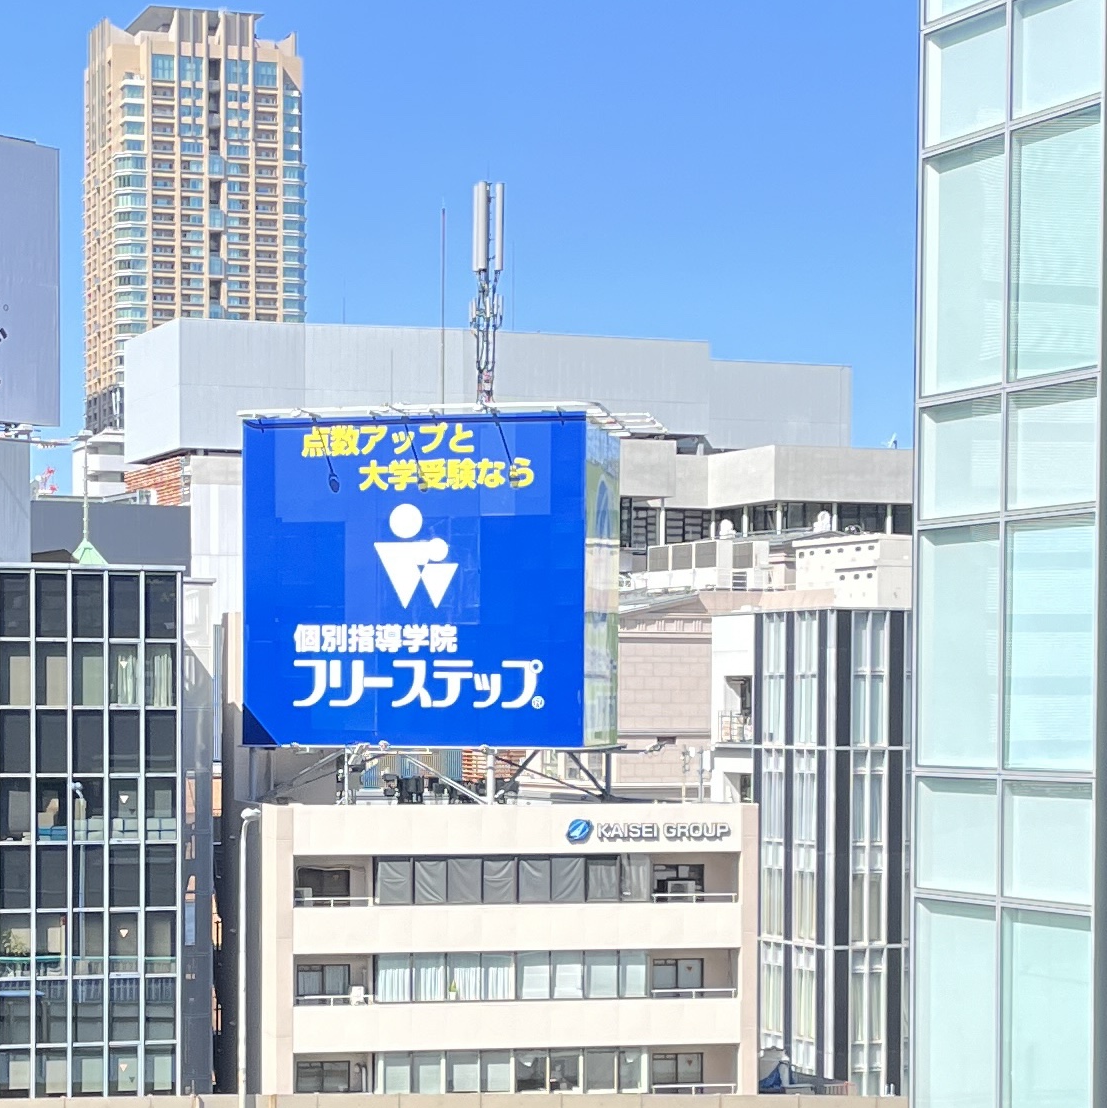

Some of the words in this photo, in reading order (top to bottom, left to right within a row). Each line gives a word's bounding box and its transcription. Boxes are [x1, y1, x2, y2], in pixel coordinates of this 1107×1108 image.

[301, 422, 474, 457] 点数アップと
[358, 457, 535, 491] 大学受験なら
[293, 624, 458, 653] 個別指導学院
[597, 823, 659, 839] KAISEI
[663, 823, 731, 839] GROUP
